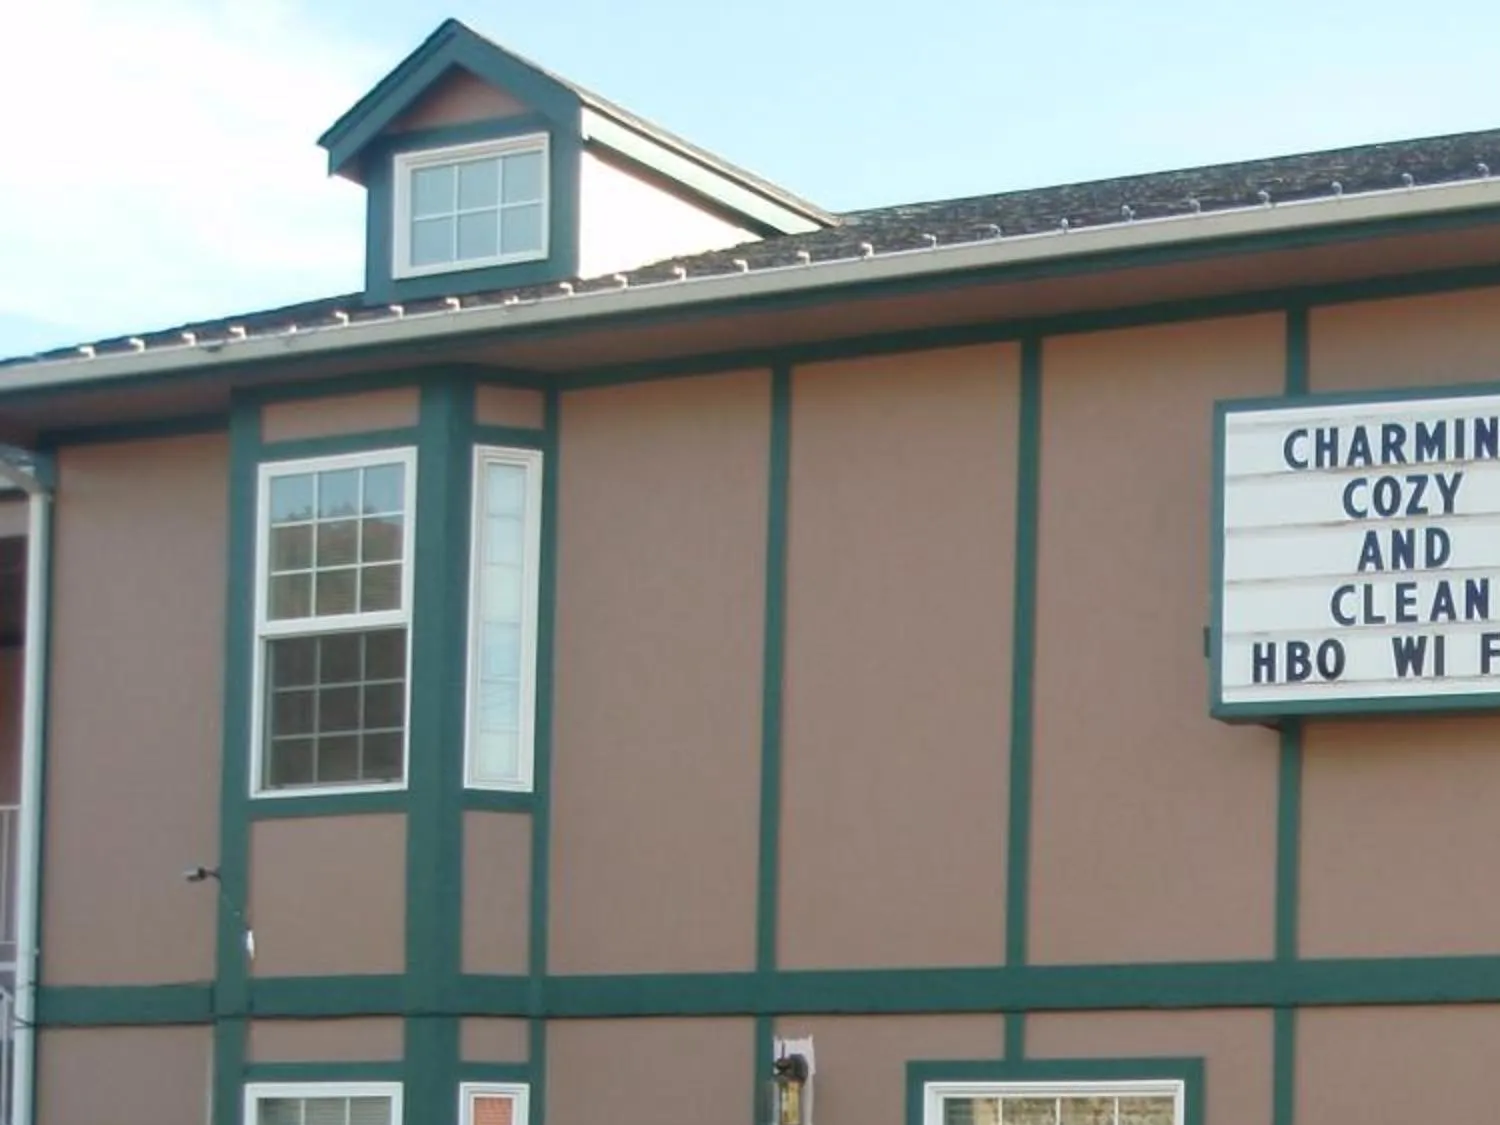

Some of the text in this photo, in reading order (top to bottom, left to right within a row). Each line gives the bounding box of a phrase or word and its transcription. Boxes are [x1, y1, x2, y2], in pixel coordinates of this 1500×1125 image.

[1342, 472, 1463, 518] COZY
[1358, 527, 1451, 572] AND
[1331, 578, 1490, 626] CLEAN
[1252, 638, 1346, 684] HBO
[1392, 635, 1446, 677] WI
